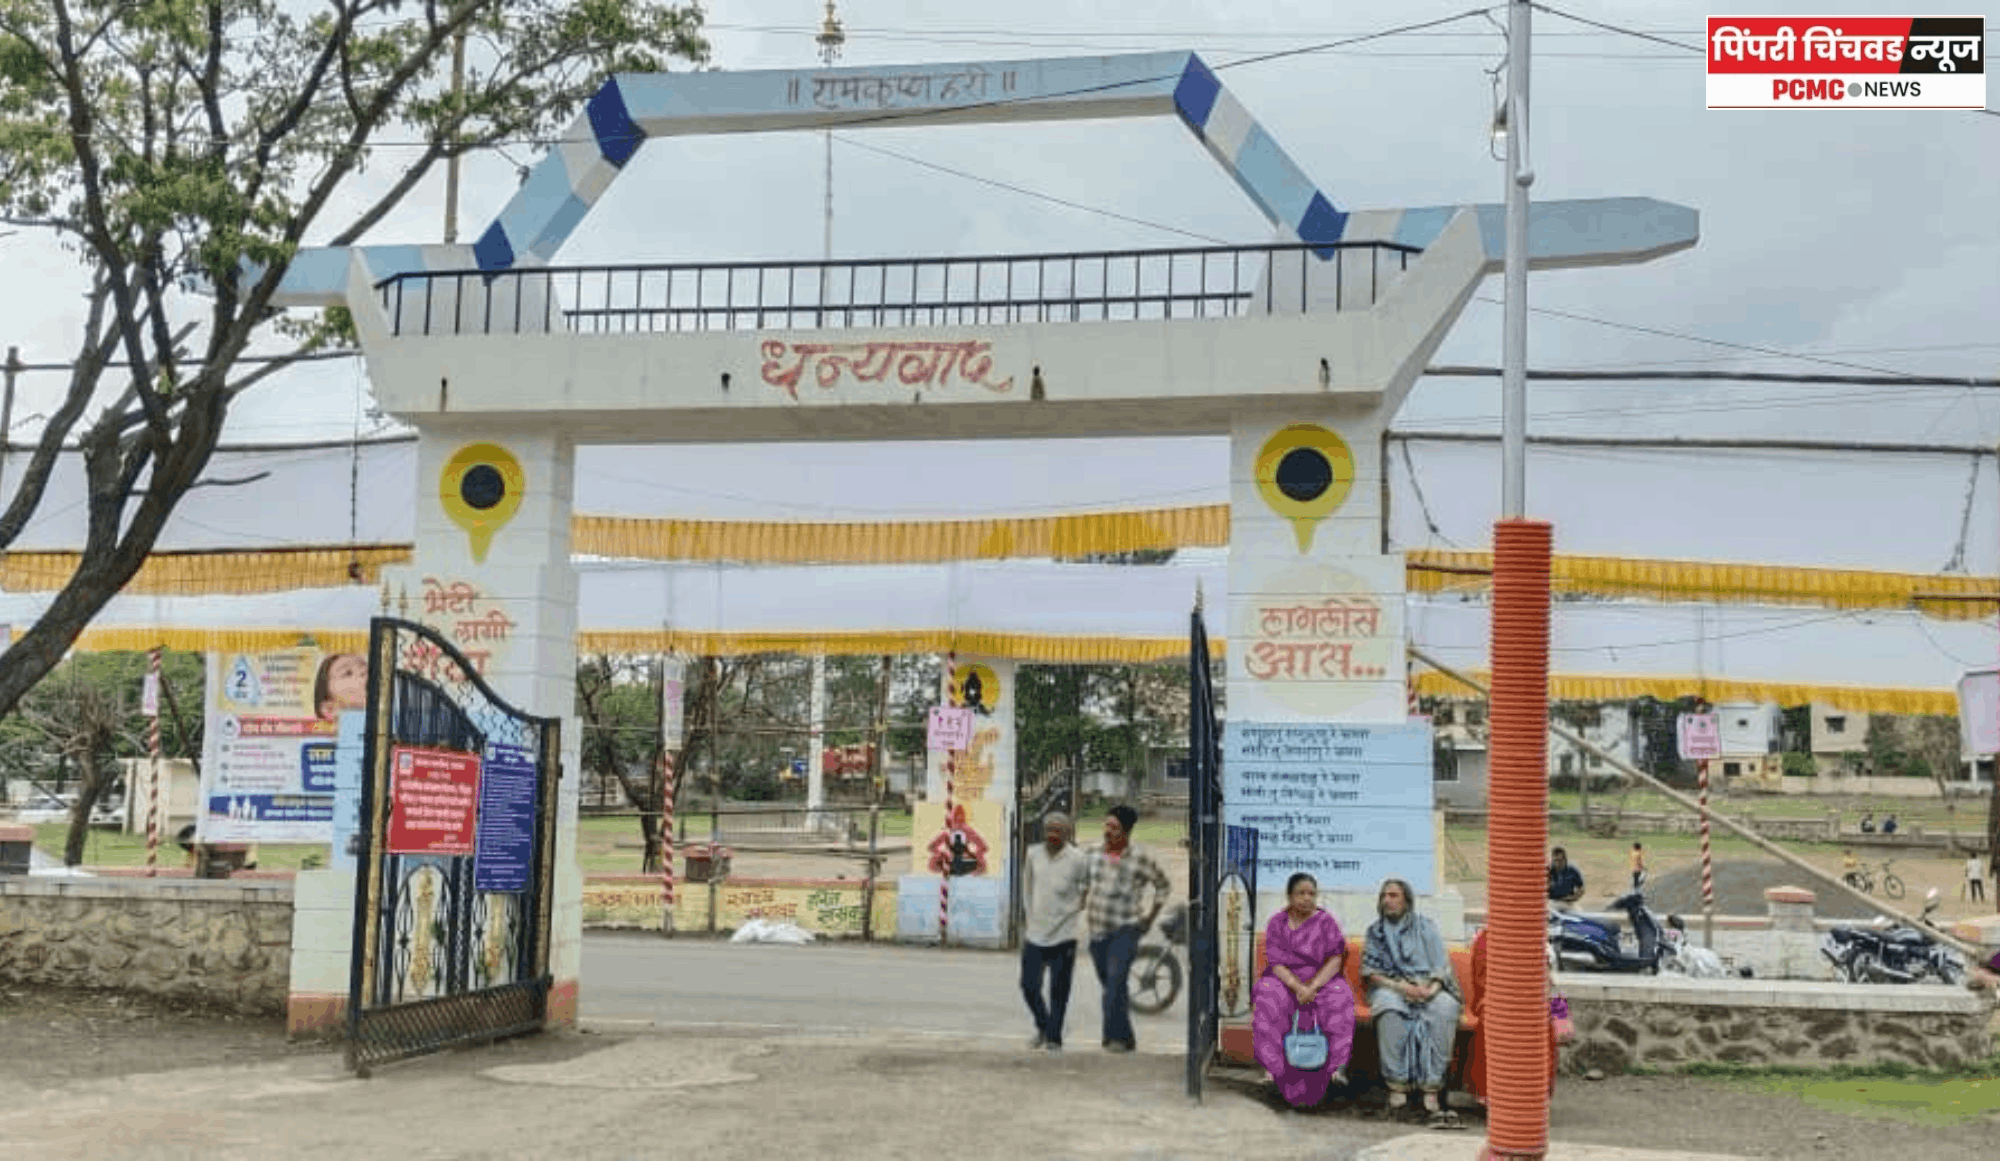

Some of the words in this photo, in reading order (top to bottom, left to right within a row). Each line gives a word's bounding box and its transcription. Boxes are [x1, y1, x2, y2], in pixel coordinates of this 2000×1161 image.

[761, 340, 1014, 400] धन्यवाद
[421, 577, 479, 614] भेटी
[1258, 598, 1381, 637] लागलीसे
[236, 670, 247, 687] 2
